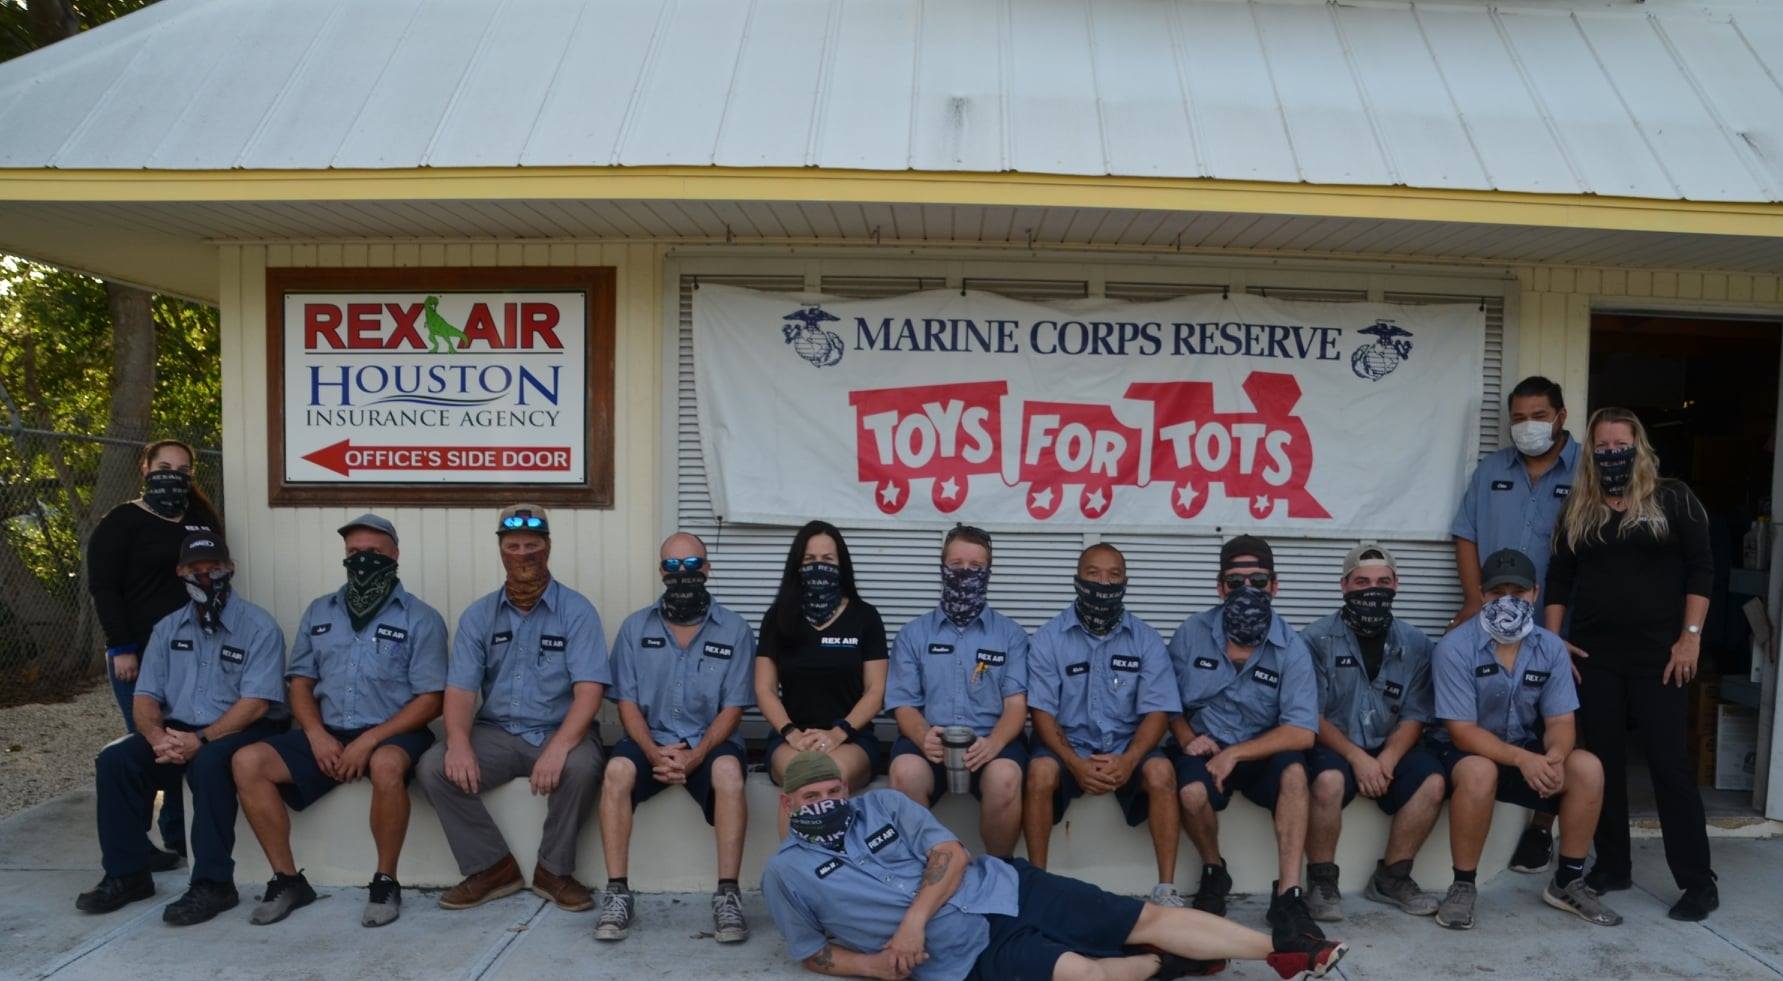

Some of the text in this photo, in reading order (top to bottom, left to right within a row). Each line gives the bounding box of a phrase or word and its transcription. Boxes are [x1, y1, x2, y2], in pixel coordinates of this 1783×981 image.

[304, 302, 564, 350] REX AIR
[854, 316, 1342, 361] MARINE CORPS RESERVE
[305, 364, 565, 407] HOUSTON
[305, 408, 560, 427] INSURANCE AGENCY
[862, 398, 1293, 487] TOYS FOR TOTS
[344, 450, 568, 468] OFFICE'S SIDE DOOR
[1555, 487, 1569, 495] REX
[378, 627, 405, 640] REX AIR
[542, 639, 564, 648] REX AIR
[821, 637, 859, 646] REX AIR
[222, 649, 242, 660] REX AIR
[705, 645, 732, 657] REX AIR
[978, 653, 1005, 663] REX AIR
[1113, 659, 1139, 669] REX AIR
[1254, 670, 1269, 681] REX
[1525, 674, 1539, 682] REX
[799, 799, 836, 816] AIR
[868, 828, 896, 850] REX AIR
